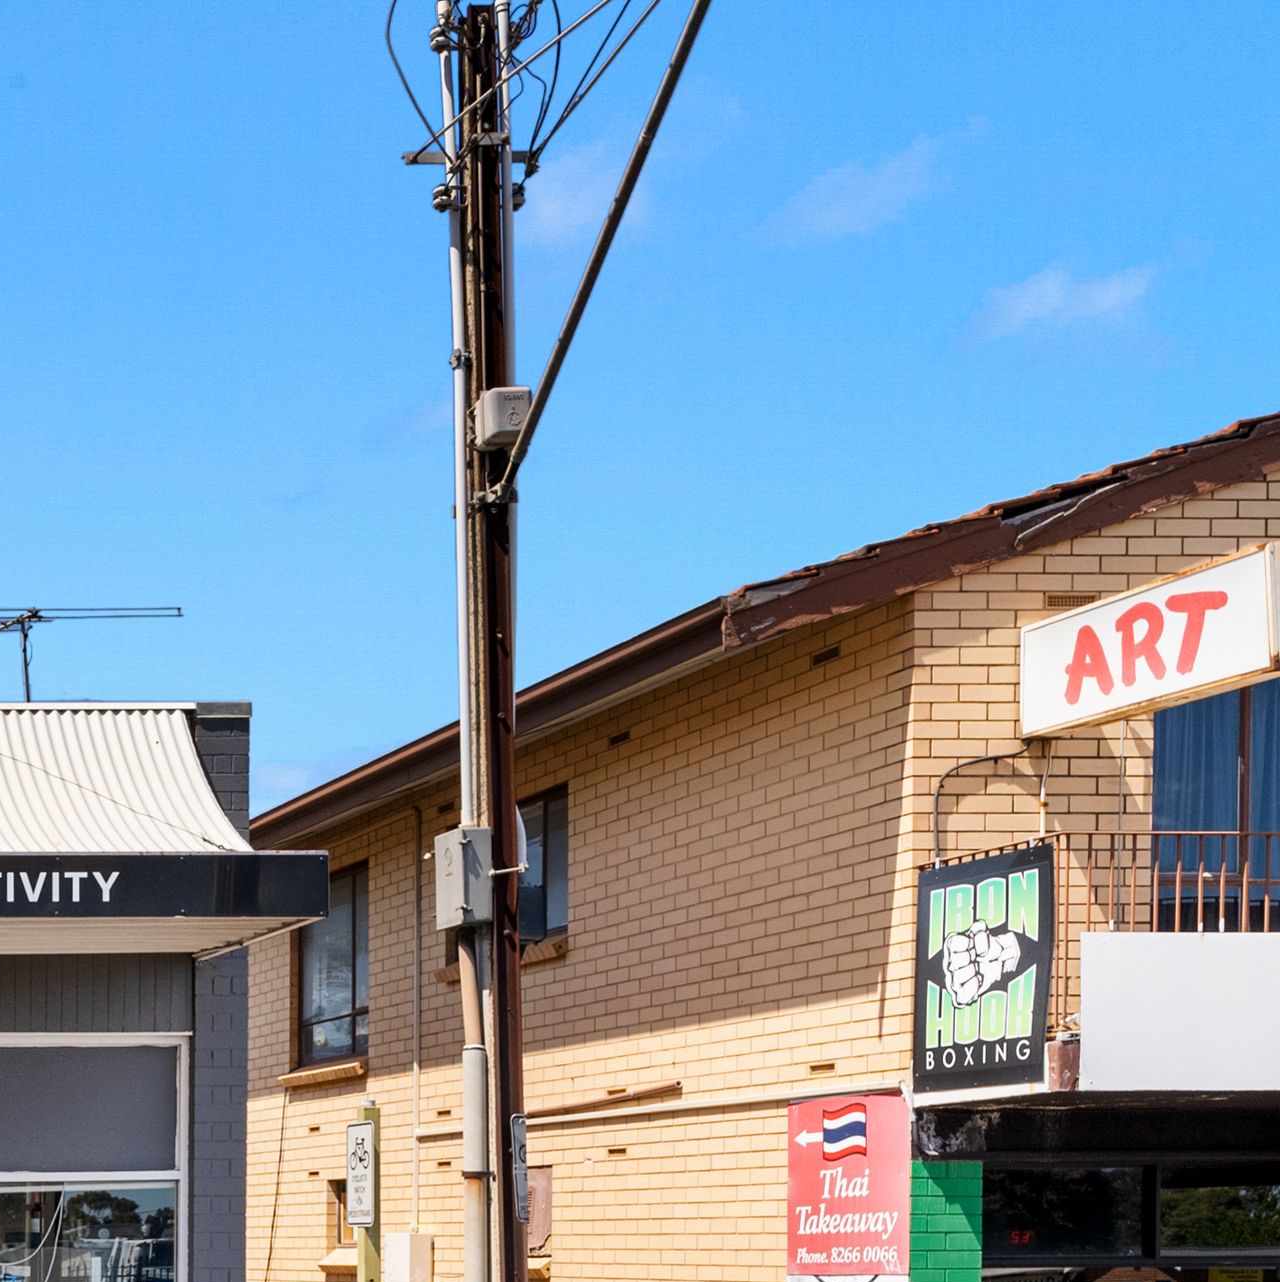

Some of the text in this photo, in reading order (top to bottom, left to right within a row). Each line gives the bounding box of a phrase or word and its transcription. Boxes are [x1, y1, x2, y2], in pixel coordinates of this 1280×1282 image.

[1064, 591, 1228, 705] ART
[928, 868, 1039, 960] IRON
[926, 963, 1037, 1049] HOOK
[926, 1039, 1031, 1070] BOXING
[820, 1166, 870, 1199] Thai
[795, 1203, 898, 1240] Takeaway
[796, 1246, 897, 1264] Phone. 8266 0066
